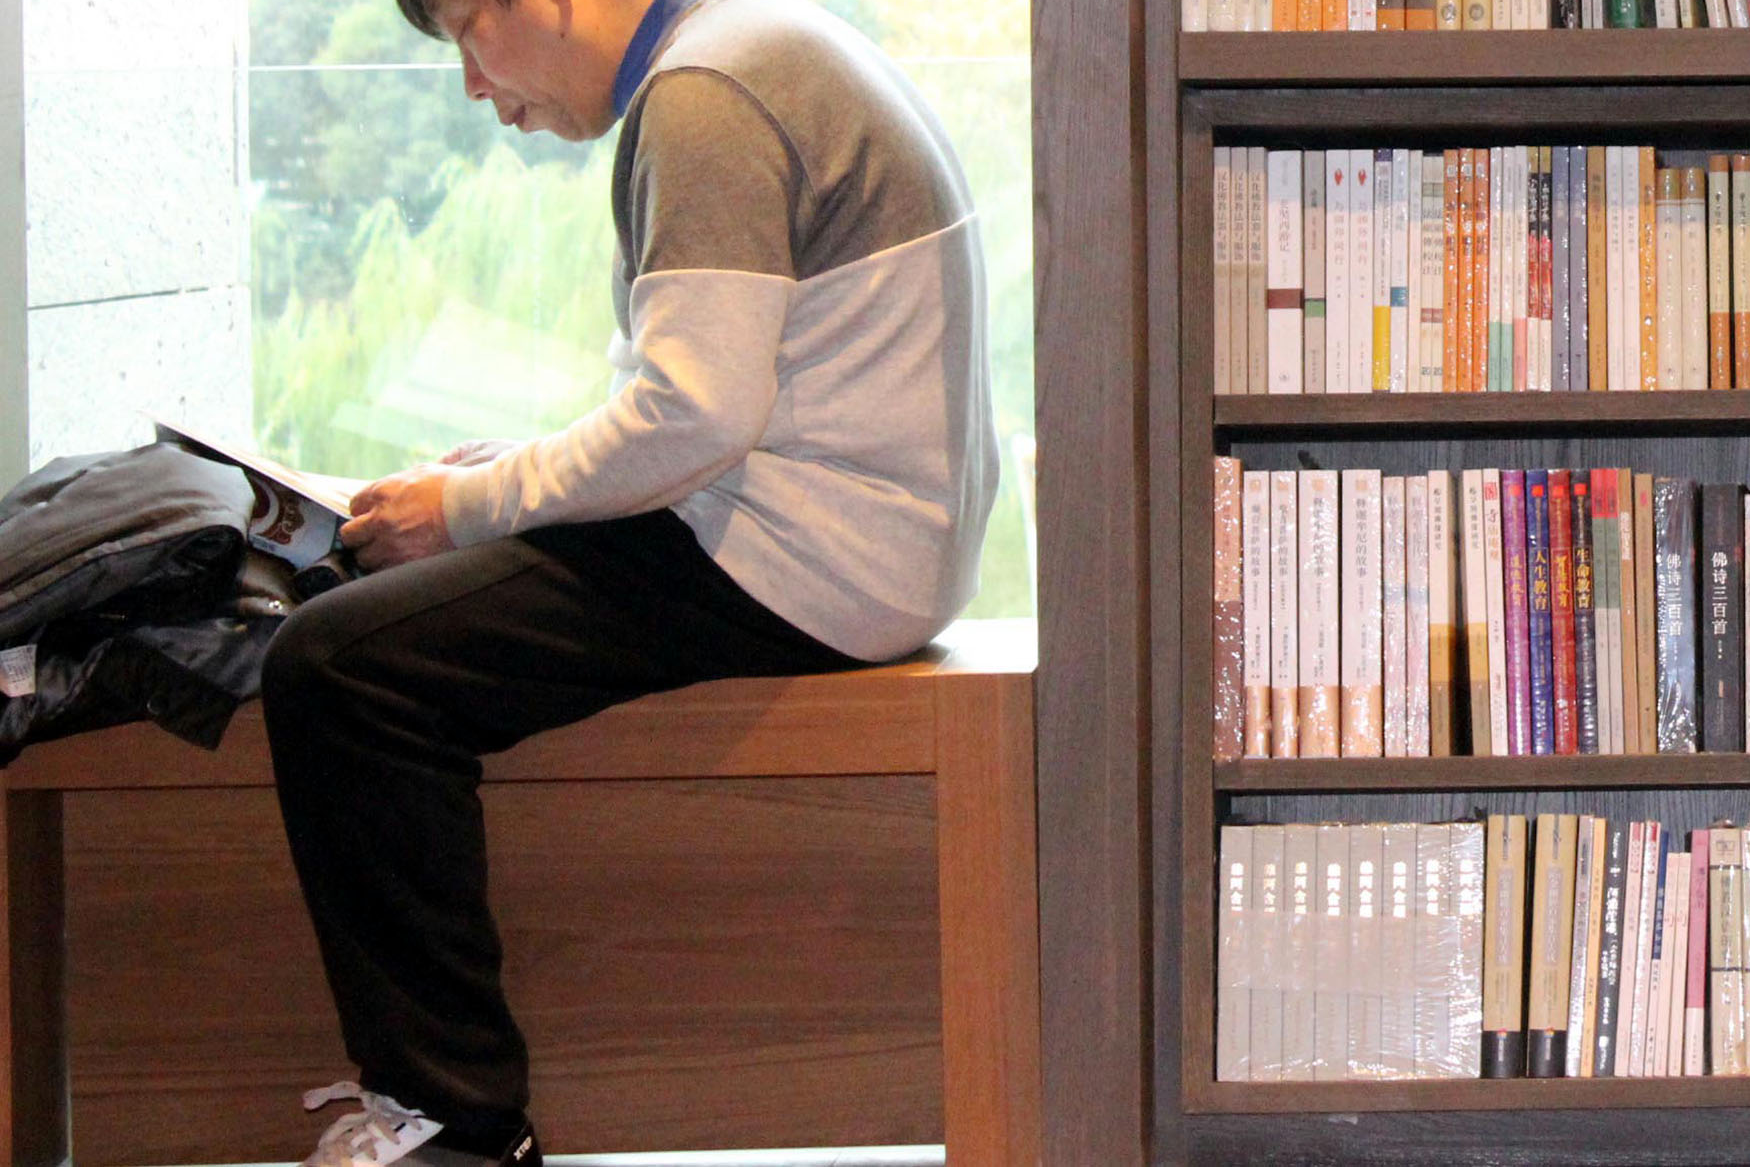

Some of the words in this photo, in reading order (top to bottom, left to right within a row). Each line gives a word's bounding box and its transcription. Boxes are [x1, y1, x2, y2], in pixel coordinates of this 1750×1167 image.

[1533, 549, 1548, 611] 人生教育
[1576, 548, 1591, 609] 生命教育
[1666, 553, 1683, 636] 佛诗三百首
[1711, 551, 1728, 635] 佛诗三百首
